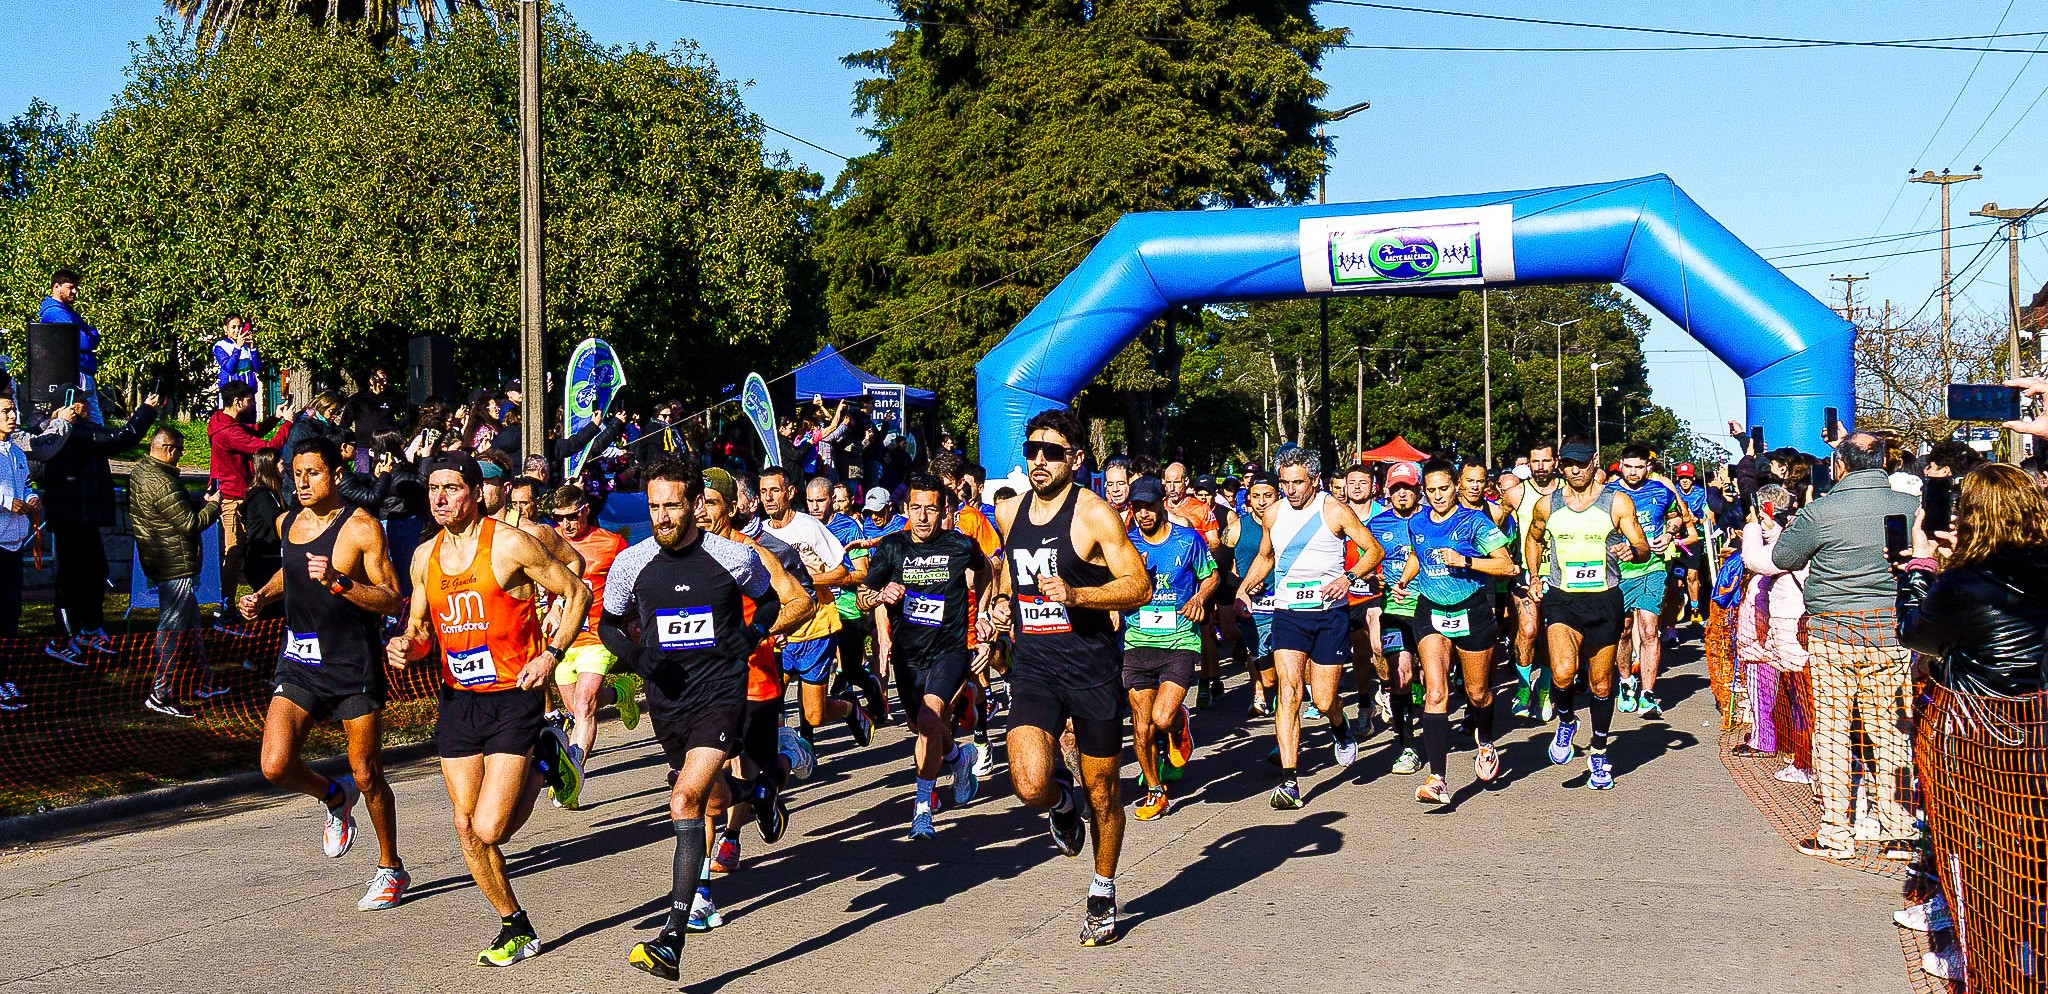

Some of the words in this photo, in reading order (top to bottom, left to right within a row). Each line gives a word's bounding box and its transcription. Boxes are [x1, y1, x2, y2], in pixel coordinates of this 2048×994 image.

[874, 398, 900, 408] anta
[903, 572, 949, 580] MARATON
[1575, 569, 1597, 579] 68
[1296, 589, 1315, 600] 88
[1023, 606, 1063, 620] 1044
[1153, 615, 1163, 624] 7
[1441, 618, 1461, 629] 23
[667, 619, 707, 635] 617
[452, 657, 485, 674] 641
